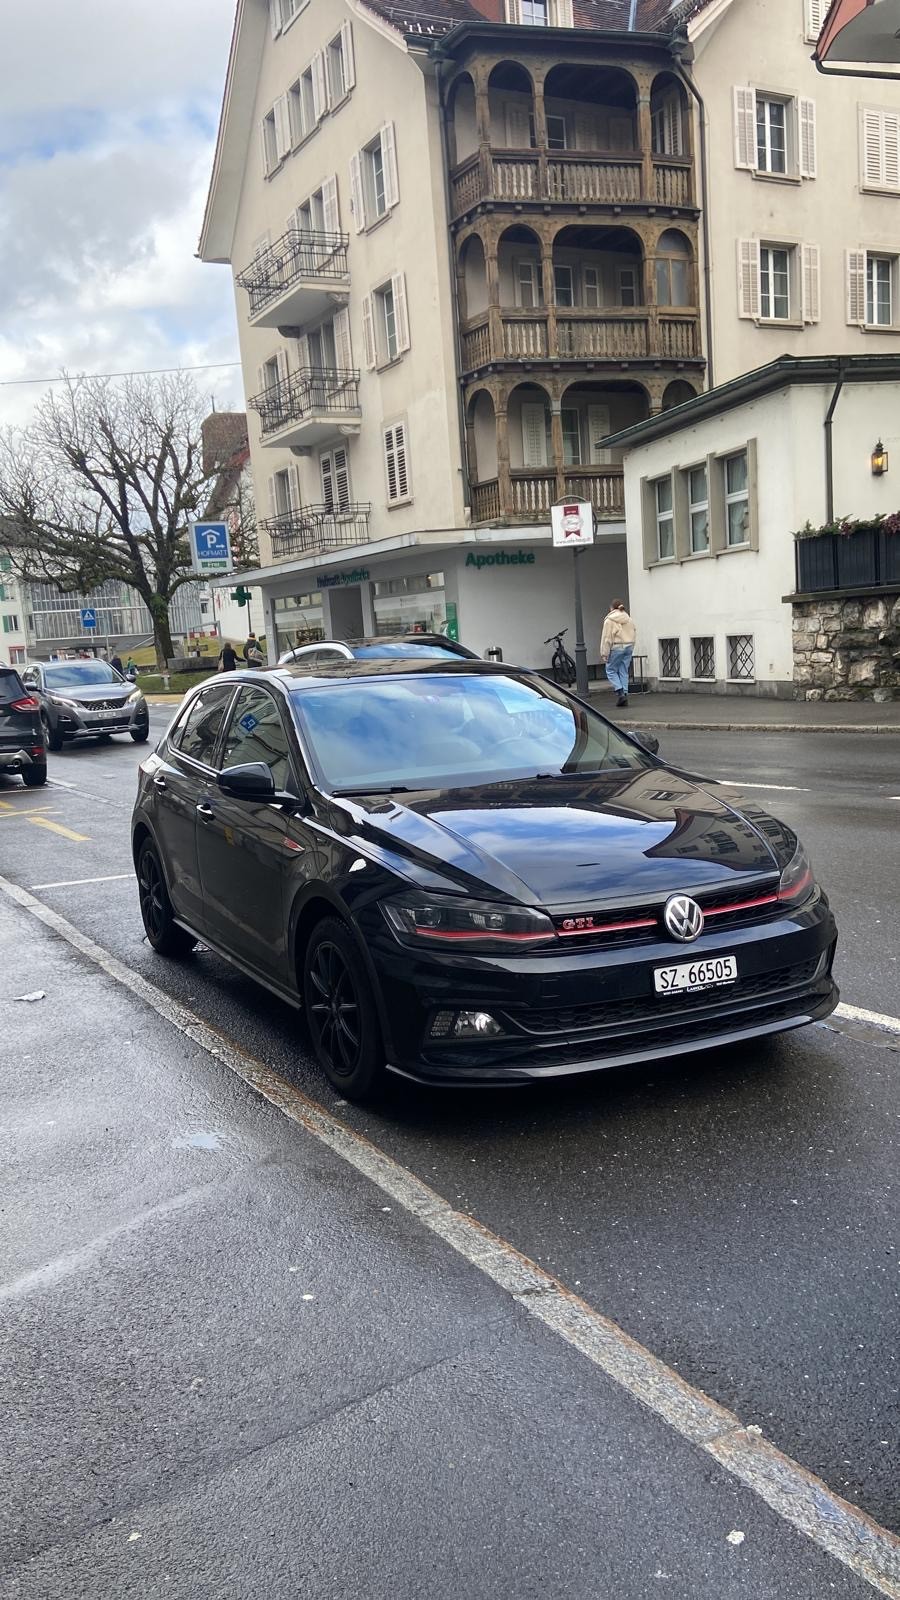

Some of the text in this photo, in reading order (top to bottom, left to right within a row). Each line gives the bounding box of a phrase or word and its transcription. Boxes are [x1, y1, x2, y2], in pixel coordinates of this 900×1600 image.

[206, 534, 217, 548] P
[198, 549, 228, 557] HOFMATT
[465, 551, 535, 569] Apotheke
[562, 916, 594, 930] GTI
